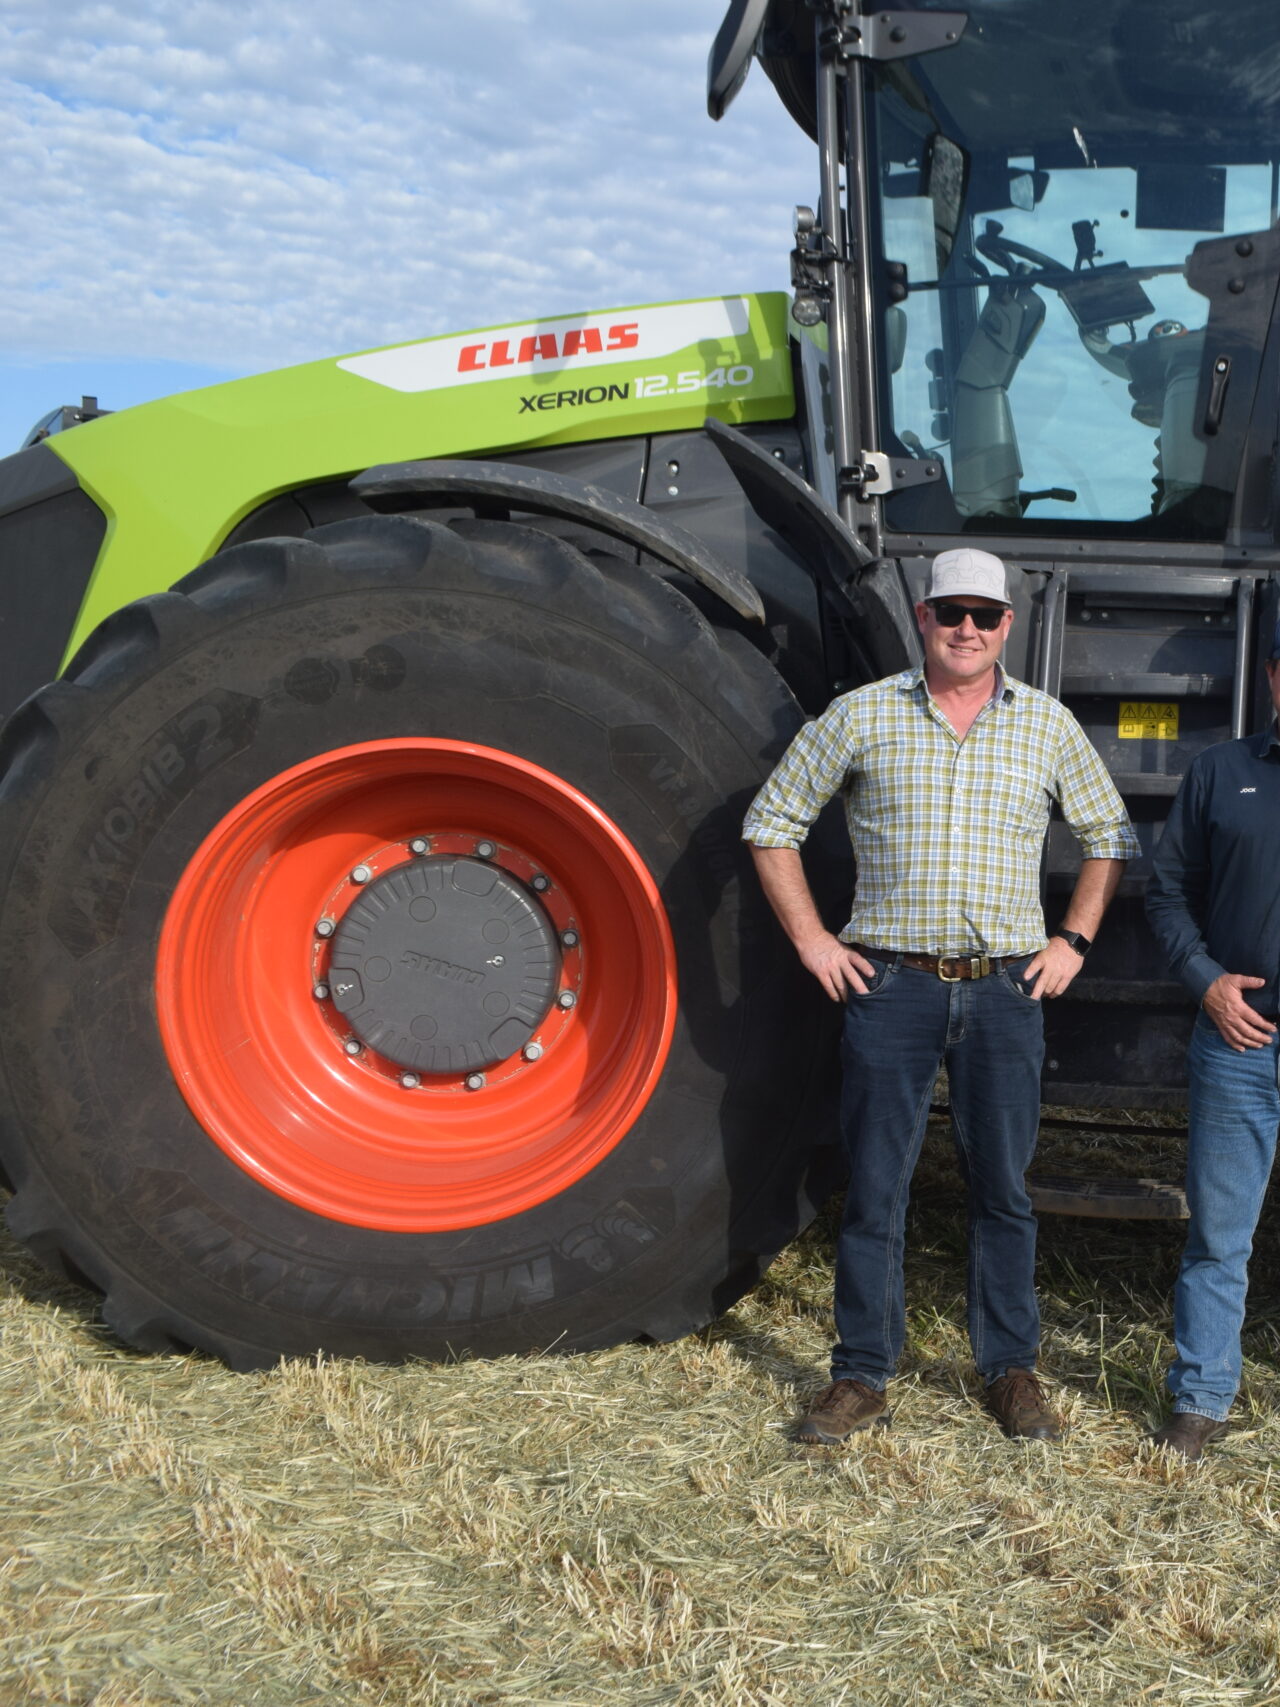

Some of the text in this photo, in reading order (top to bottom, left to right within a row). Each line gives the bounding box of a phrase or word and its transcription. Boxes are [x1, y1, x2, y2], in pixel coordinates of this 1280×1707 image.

[457, 323, 639, 372] CLAAS
[518, 365, 754, 414] XERION 12.540
